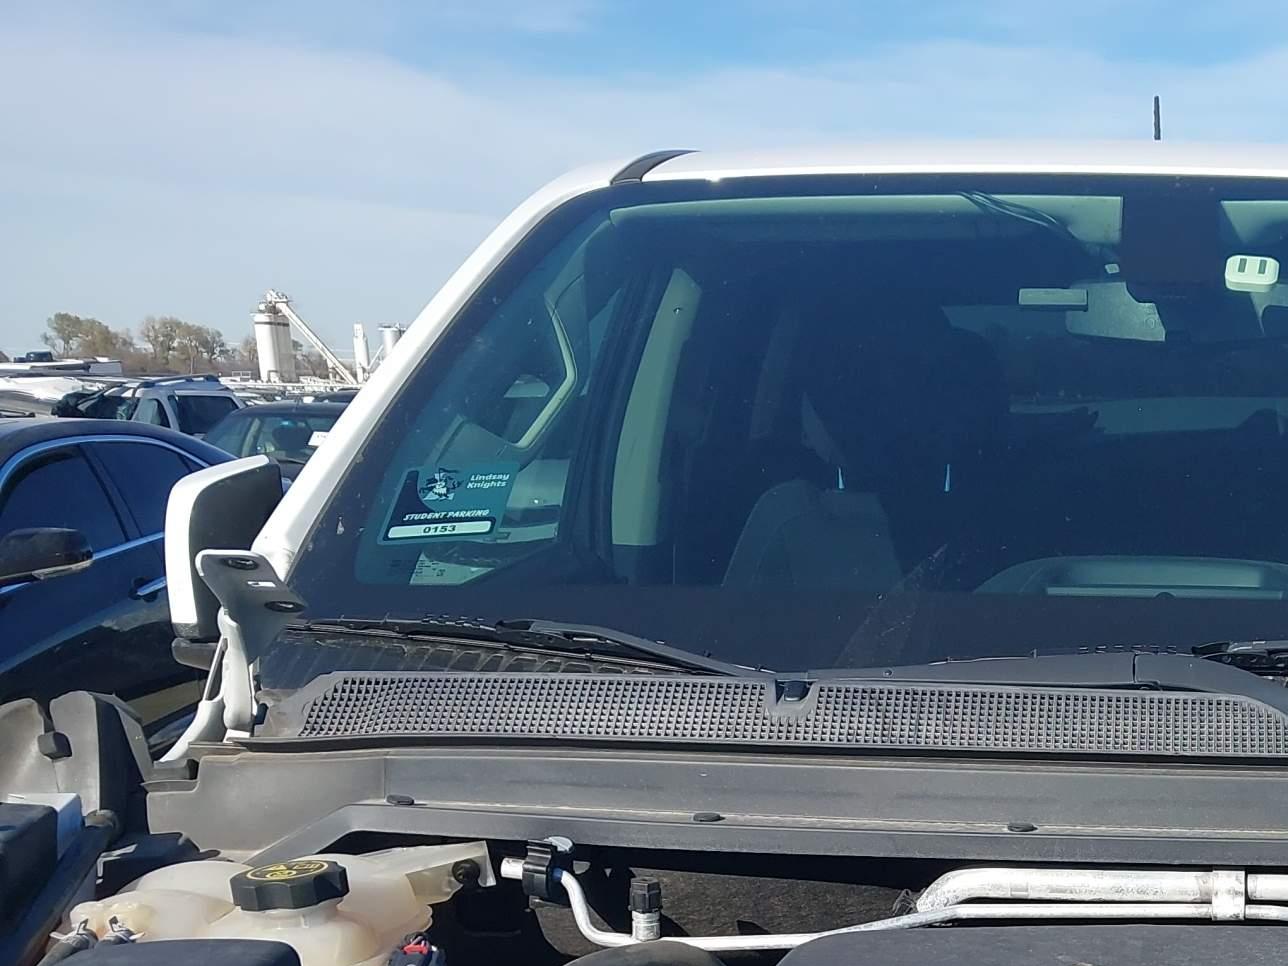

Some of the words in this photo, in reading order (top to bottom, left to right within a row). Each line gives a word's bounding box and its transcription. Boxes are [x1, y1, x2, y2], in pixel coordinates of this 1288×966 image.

[471, 473, 510, 482] Lindsay
[467, 481, 507, 489] Knights
[403, 512, 446, 521] STUDENT
[447, 509, 490, 518] PARKING
[423, 525, 456, 534] 0153
